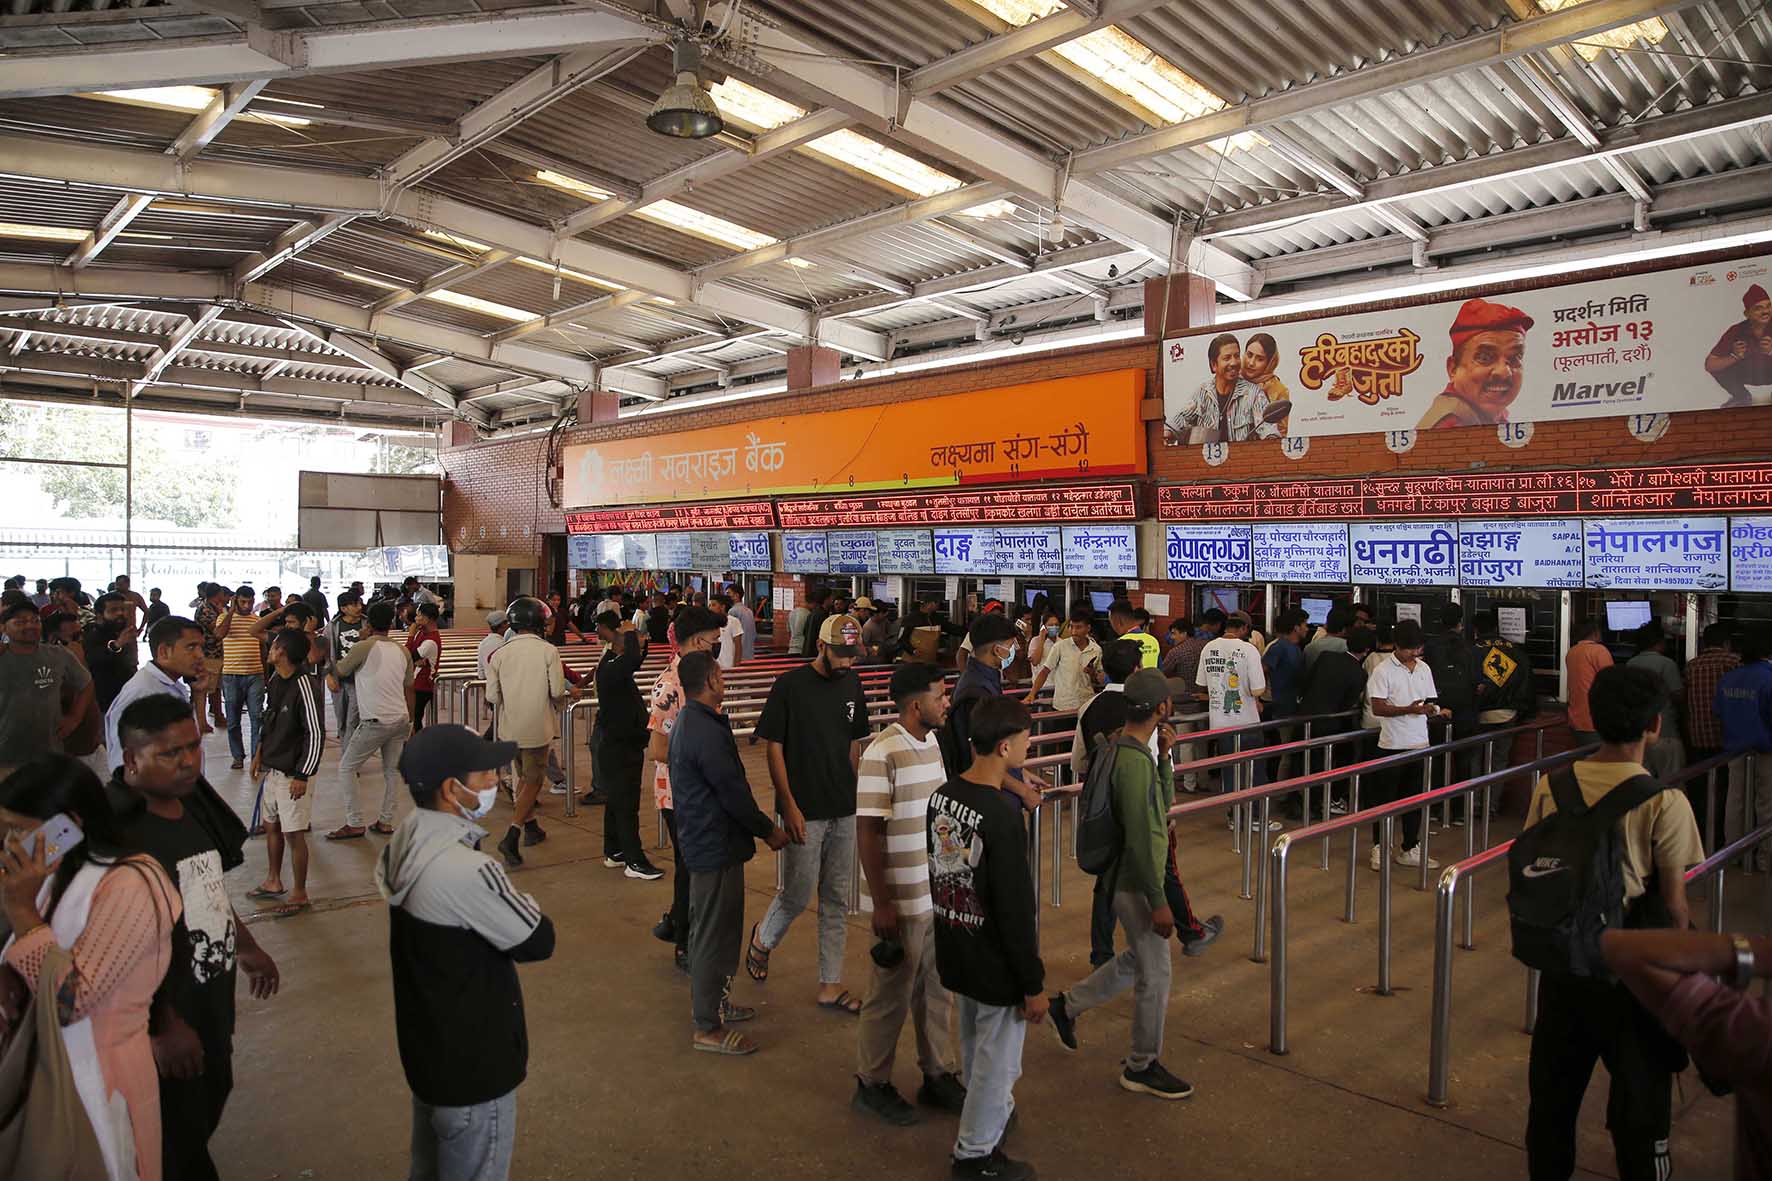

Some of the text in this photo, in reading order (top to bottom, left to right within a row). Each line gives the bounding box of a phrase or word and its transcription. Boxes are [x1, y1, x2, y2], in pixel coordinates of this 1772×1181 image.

[1553, 294, 1650, 324] प्रदर्शन मिति
[1552, 320, 1653, 350] असोज १३
[1300, 328, 1424, 389] हरिबहादुरको
[1553, 348, 1618, 373] (फूलपाती,
[1552, 376, 1647, 402] Marvel
[1504, 423, 1525, 441] 16
[1635, 414, 1657, 434] 17
[931, 422, 1089, 468] लक्ष्यमा संग-संगै
[1286, 437, 1303, 452] 14
[1390, 431, 1409, 448] 15
[745, 434, 786, 473] बैंक
[1206, 443, 1222, 460] 13
[1010, 464, 1020, 478] 11
[1078, 459, 1089, 472] 12
[848, 476, 854, 487] 8
[903, 473, 909, 485] 9
[954, 470, 963, 482] 10
[1464, 478, 1515, 491] यातायात
[1609, 471, 1634, 487] भेरी
[1648, 468, 1707, 487] बागेश्वरी
[1313, 485, 1354, 497] यातायात
[995, 530, 1048, 549] नेपालगंज
[1073, 531, 1128, 549] महेन्द्रनगर
[1270, 529, 1301, 542] पोखरा
[1461, 531, 1521, 552] बझाङ्ग
[1552, 533, 1581, 541] SAIPAL
[1586, 523, 1725, 553] नेपालगंज
[934, 534, 973, 562] दाङ्ग
[1167, 531, 1251, 561] नेपालगंज
[1354, 529, 1457, 564] धनगढी
[1168, 561, 1211, 579] सल्यान
[1589, 553, 1721, 569] गुलरिया राजापुर
[1424, 565, 1456, 577] भजनी
[1461, 560, 1523, 582] बाजुरा
[1536, 857, 1561, 868] NIKE
